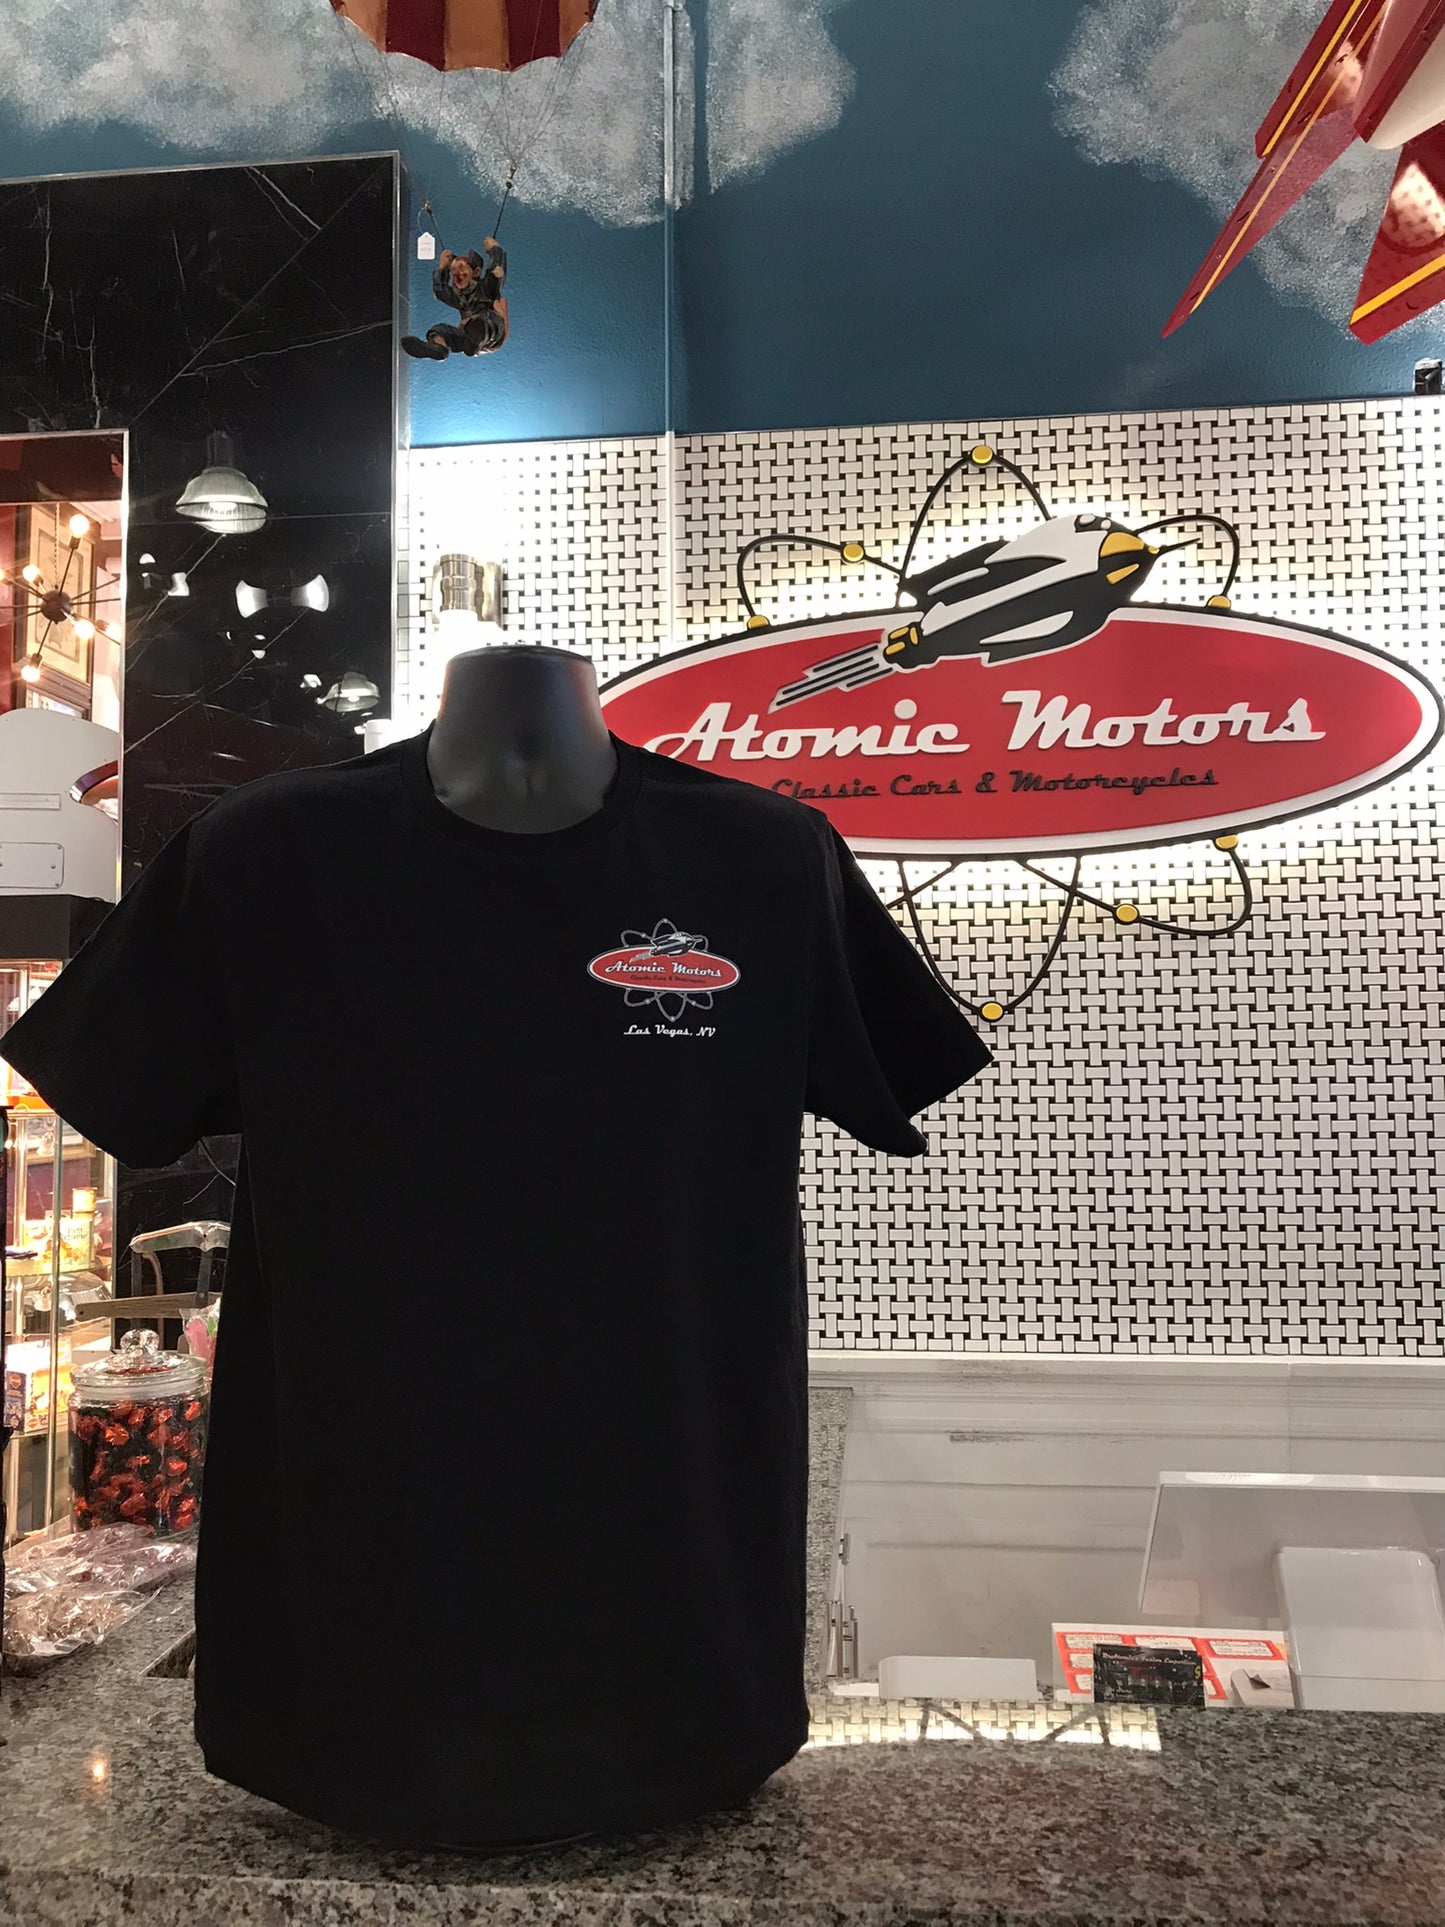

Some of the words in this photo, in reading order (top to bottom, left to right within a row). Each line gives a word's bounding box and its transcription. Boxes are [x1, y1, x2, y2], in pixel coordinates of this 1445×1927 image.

[642, 698, 970, 762] Atomic
[1001, 689, 1327, 751] Motors
[771, 778, 881, 800] Classic
[890, 774, 962, 796] Cars
[975, 771, 998, 793] &
[1009, 767, 1219, 795] Motorcycles
[605, 961, 666, 973] Atomic
[671, 962, 722, 977] Motors
[623, 1024, 651, 1035] Las
[654, 1024, 693, 1038] Vegas,
[696, 1026, 717, 1038] NV
